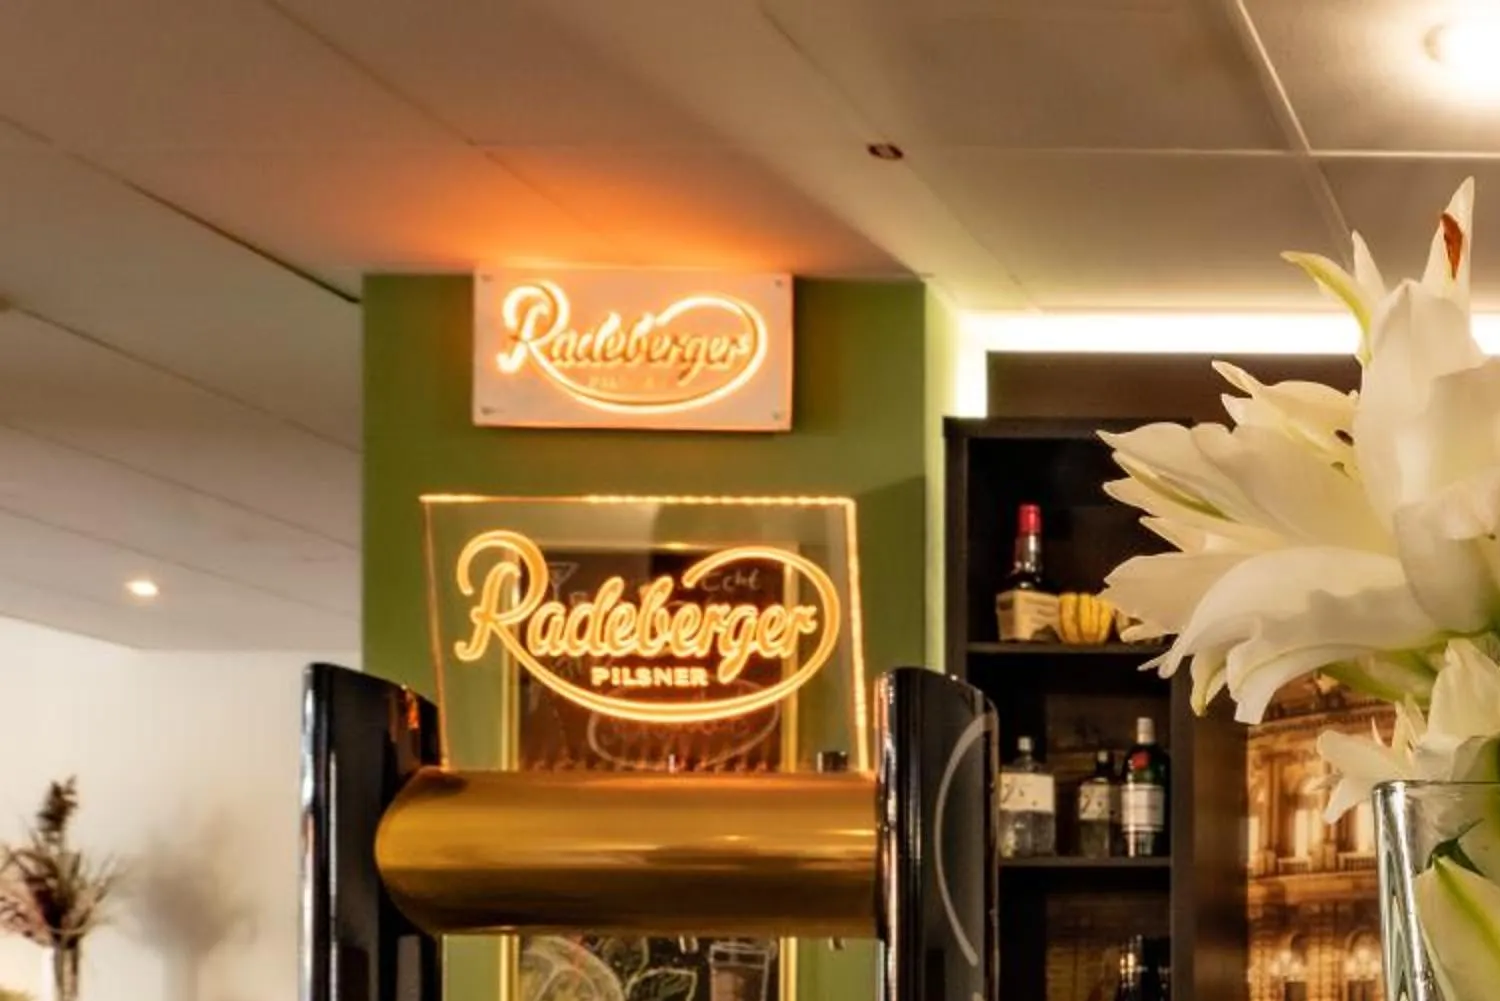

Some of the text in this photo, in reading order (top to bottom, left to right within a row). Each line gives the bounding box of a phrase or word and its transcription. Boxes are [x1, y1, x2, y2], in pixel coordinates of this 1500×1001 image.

[496, 279, 768, 413] Radeberger
[454, 530, 841, 722] Radeberger
[590, 666, 709, 687] PILSNER
